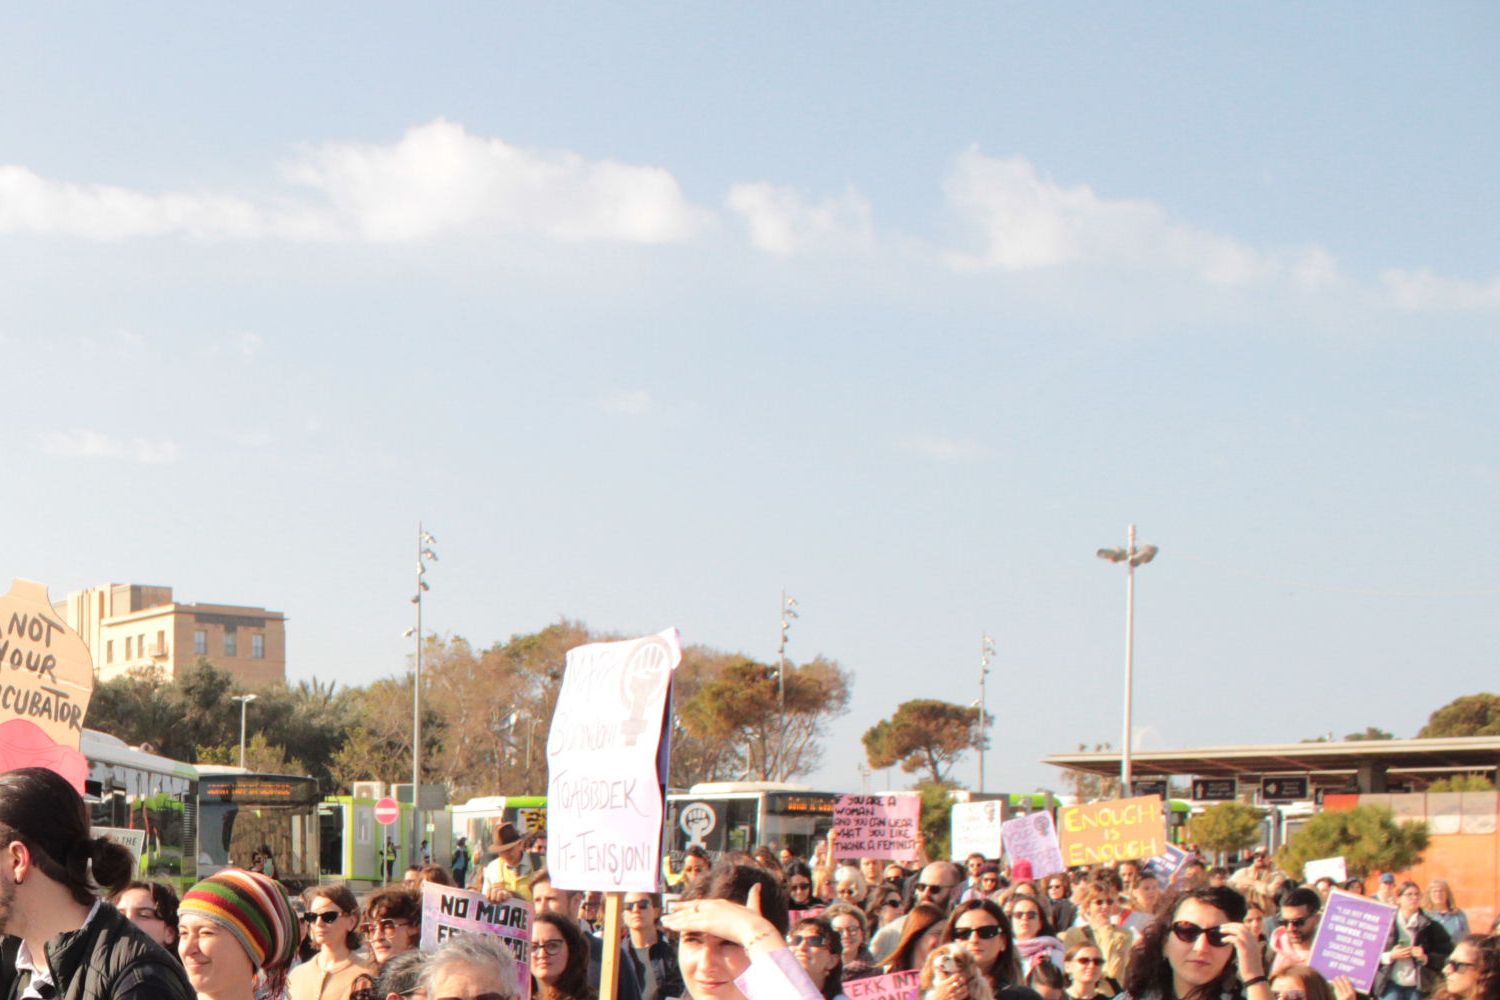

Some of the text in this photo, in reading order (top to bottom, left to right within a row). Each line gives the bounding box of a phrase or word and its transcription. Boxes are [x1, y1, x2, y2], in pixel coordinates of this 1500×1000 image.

[8, 611, 66, 648] NOT
[552, 769, 650, 819] TQABBDEK
[847, 796, 864, 806] YOU
[865, 796, 884, 807] ARE
[888, 796, 897, 807] A
[834, 807, 874, 816] WOMAN
[1064, 803, 1155, 832] ENOUGH
[834, 817, 912, 828] AND YOU CAN WEAR
[868, 828, 884, 837] YOU
[889, 828, 910, 838] LIKE
[1104, 828, 1120, 841] IS
[834, 839, 916, 852] THANK A FEMINIST
[1069, 837, 1156, 866] ENOUGH
[556, 829, 651, 886] IT-TENSJONI
[440, 893, 529, 931] NO MORE
